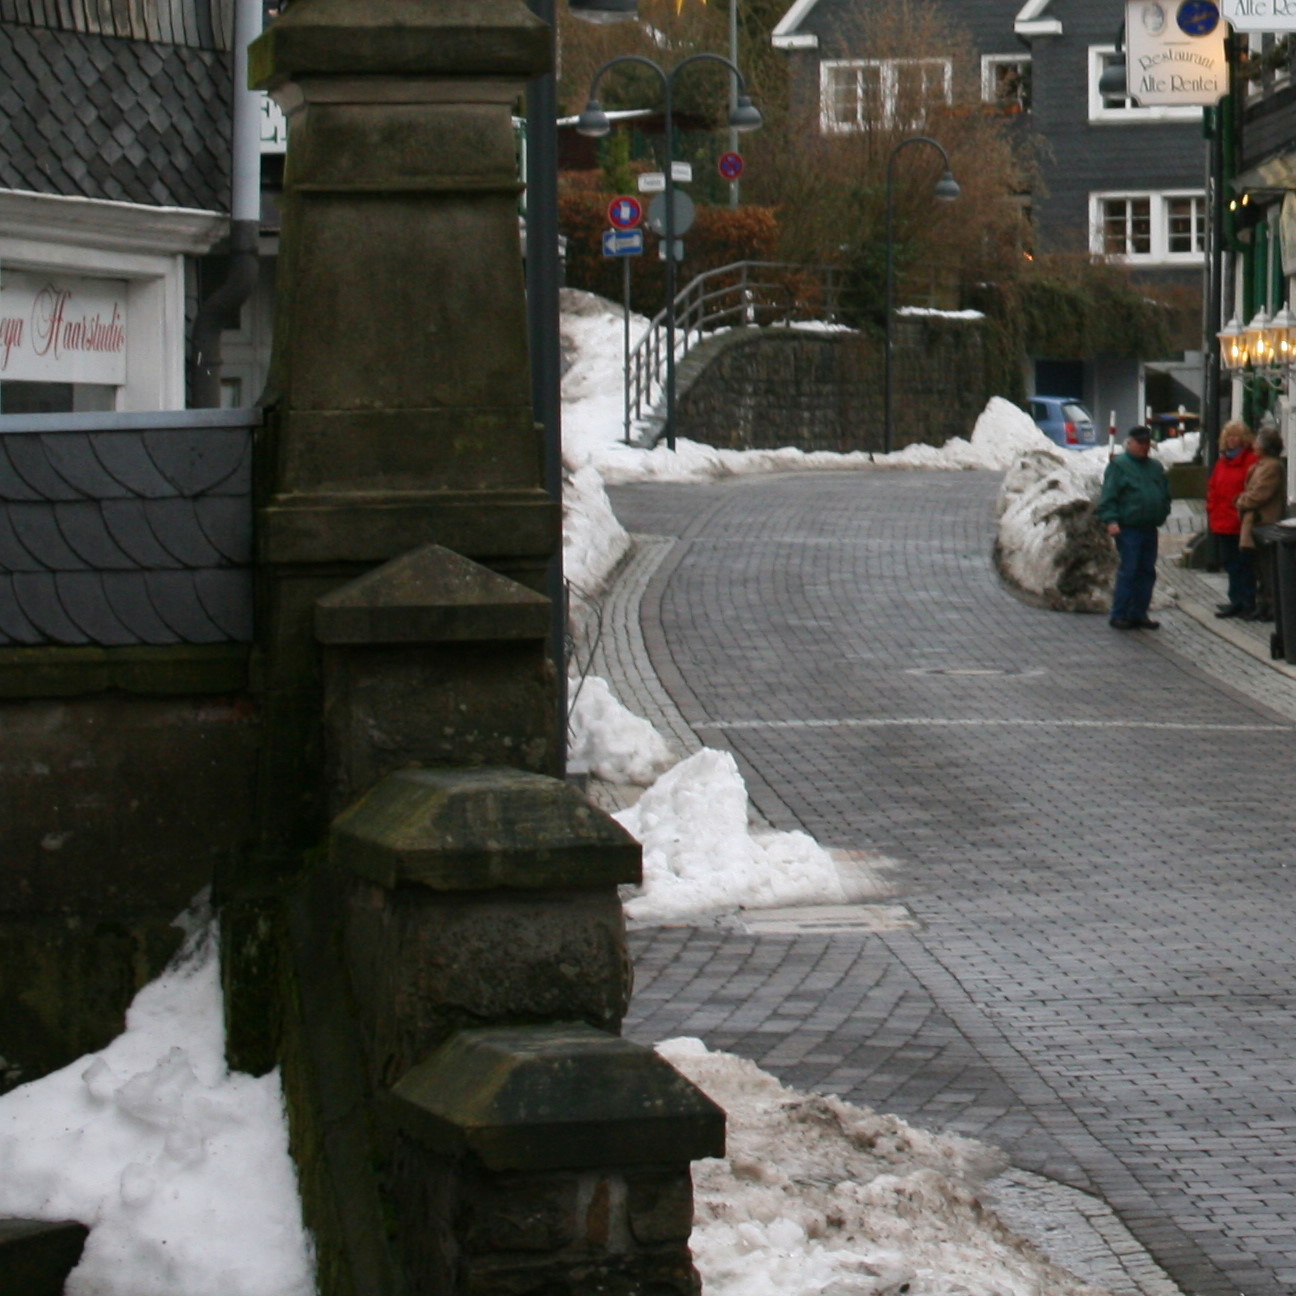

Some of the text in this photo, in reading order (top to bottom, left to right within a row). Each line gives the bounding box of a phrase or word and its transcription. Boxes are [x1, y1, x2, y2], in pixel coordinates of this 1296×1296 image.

[1138, 48, 1216, 71] Restaurant
[1140, 74, 1218, 93] Alte Rentei
